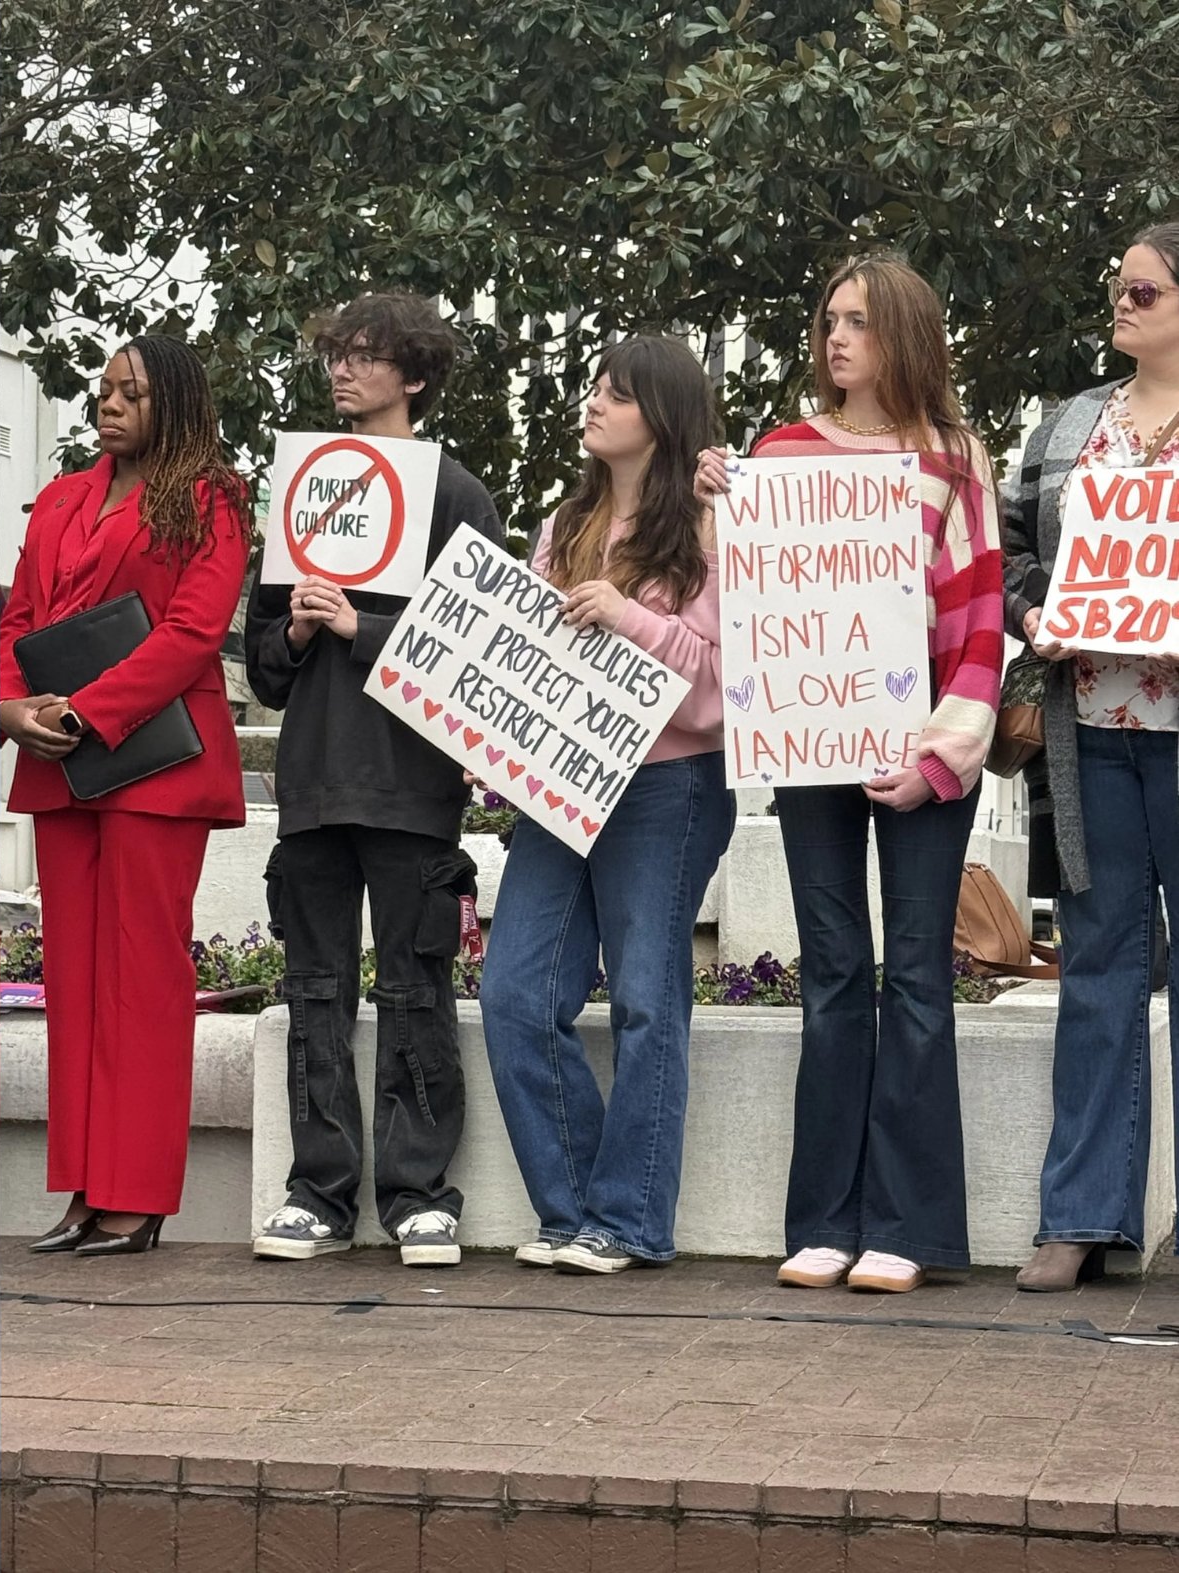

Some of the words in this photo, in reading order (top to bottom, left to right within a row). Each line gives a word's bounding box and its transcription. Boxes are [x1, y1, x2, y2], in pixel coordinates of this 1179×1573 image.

[308, 477, 371, 506] PURITY
[724, 470, 919, 529] WITHHOLDING
[296, 510, 369, 538] CULTURE
[725, 535, 916, 594] INFORMATION
[453, 540, 566, 637] SUPPORT
[567, 622, 668, 708] POLICIES
[752, 609, 829, 662] ISN'T
[845, 612, 869, 652] A
[1045, 595, 1179, 643] SB20
[420, 578, 489, 638] THAT
[481, 623, 584, 712] PROTECT
[574, 691, 650, 770] YOUTH,
[762, 668, 876, 714] LOVE
[394, 624, 453, 675] NOT
[448, 662, 558, 755] RESTRICT
[549, 732, 626, 812] THEM!
[733, 727, 919, 779] LANGUAGE
